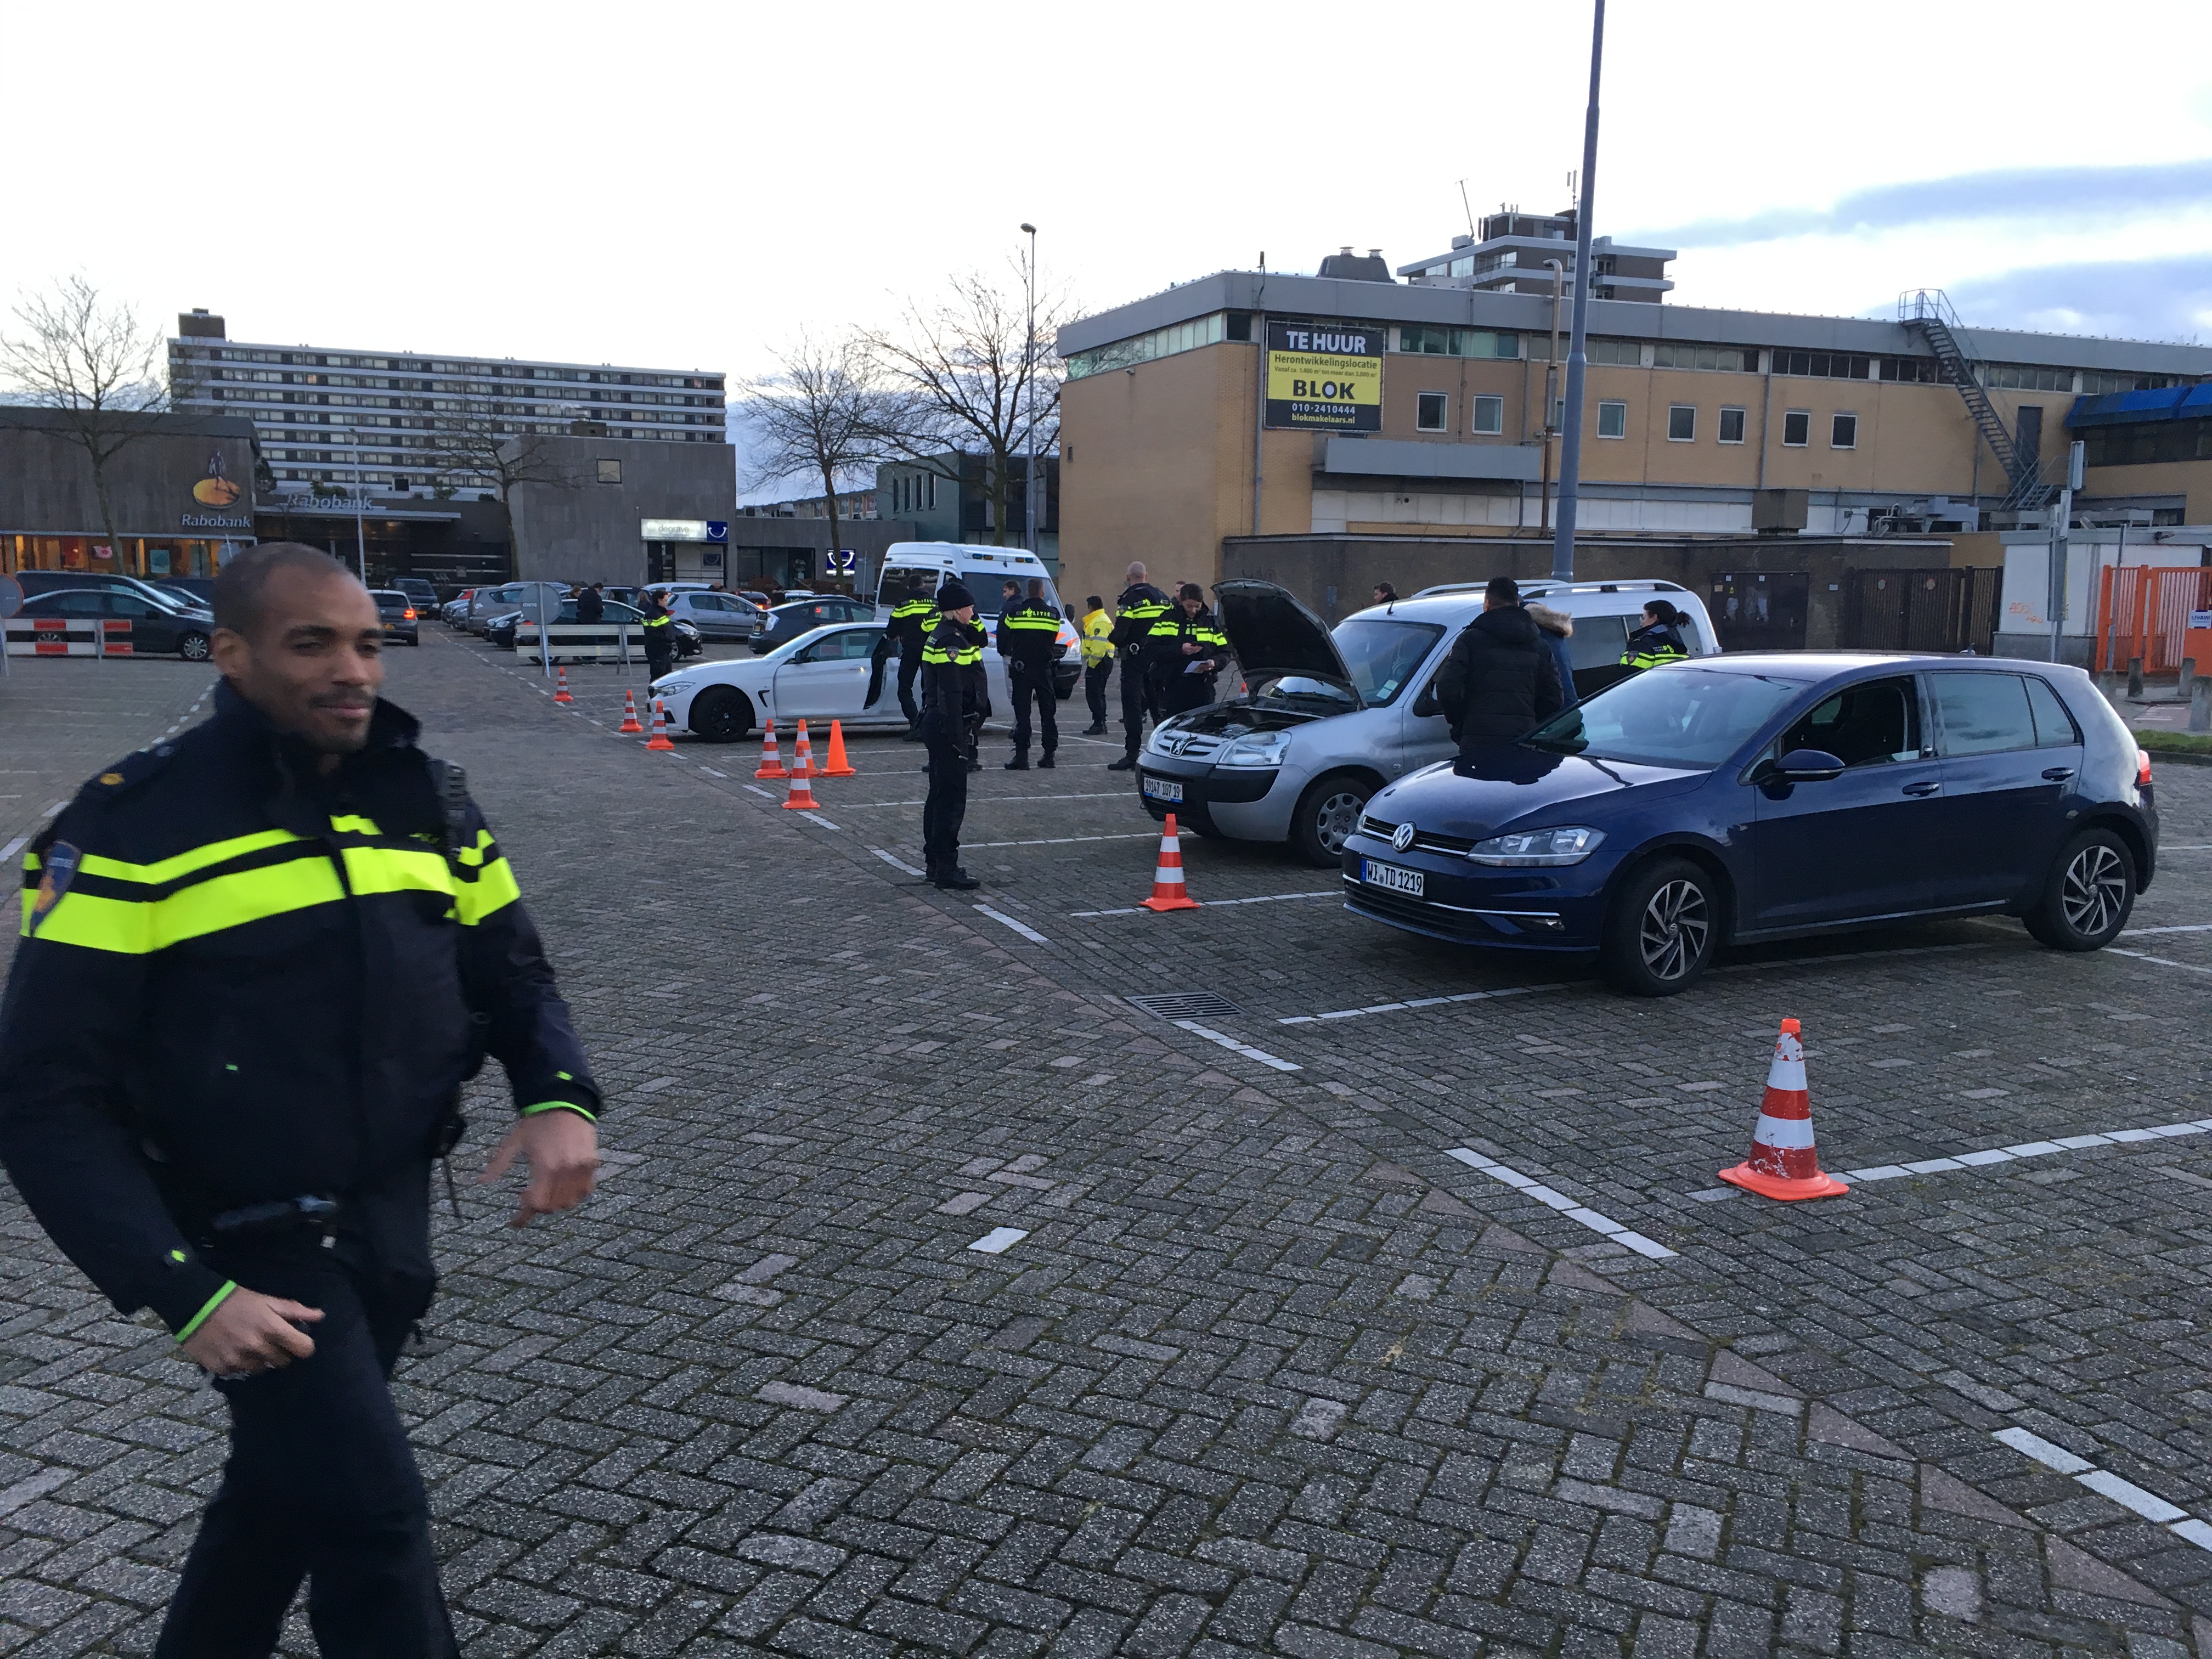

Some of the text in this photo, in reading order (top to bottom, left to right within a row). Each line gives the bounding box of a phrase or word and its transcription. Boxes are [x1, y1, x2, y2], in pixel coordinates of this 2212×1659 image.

[1286, 331, 1366, 353] TE HUUR
[1274, 354, 1378, 369] Herontwikkelingslocatie
[1293, 379, 1355, 400] BLOK
[1291, 413, 1355, 424] blokmakelaars.nl
[287, 493, 373, 510] Rabobank
[182, 514, 251, 527] Rabobank
[658, 524, 690, 533] degrave
[1162, 783, 1172, 797] 107
[1173, 785, 1180, 798] 19
[1384, 867, 1396, 886] TD
[1398, 871, 1422, 893] 1219
